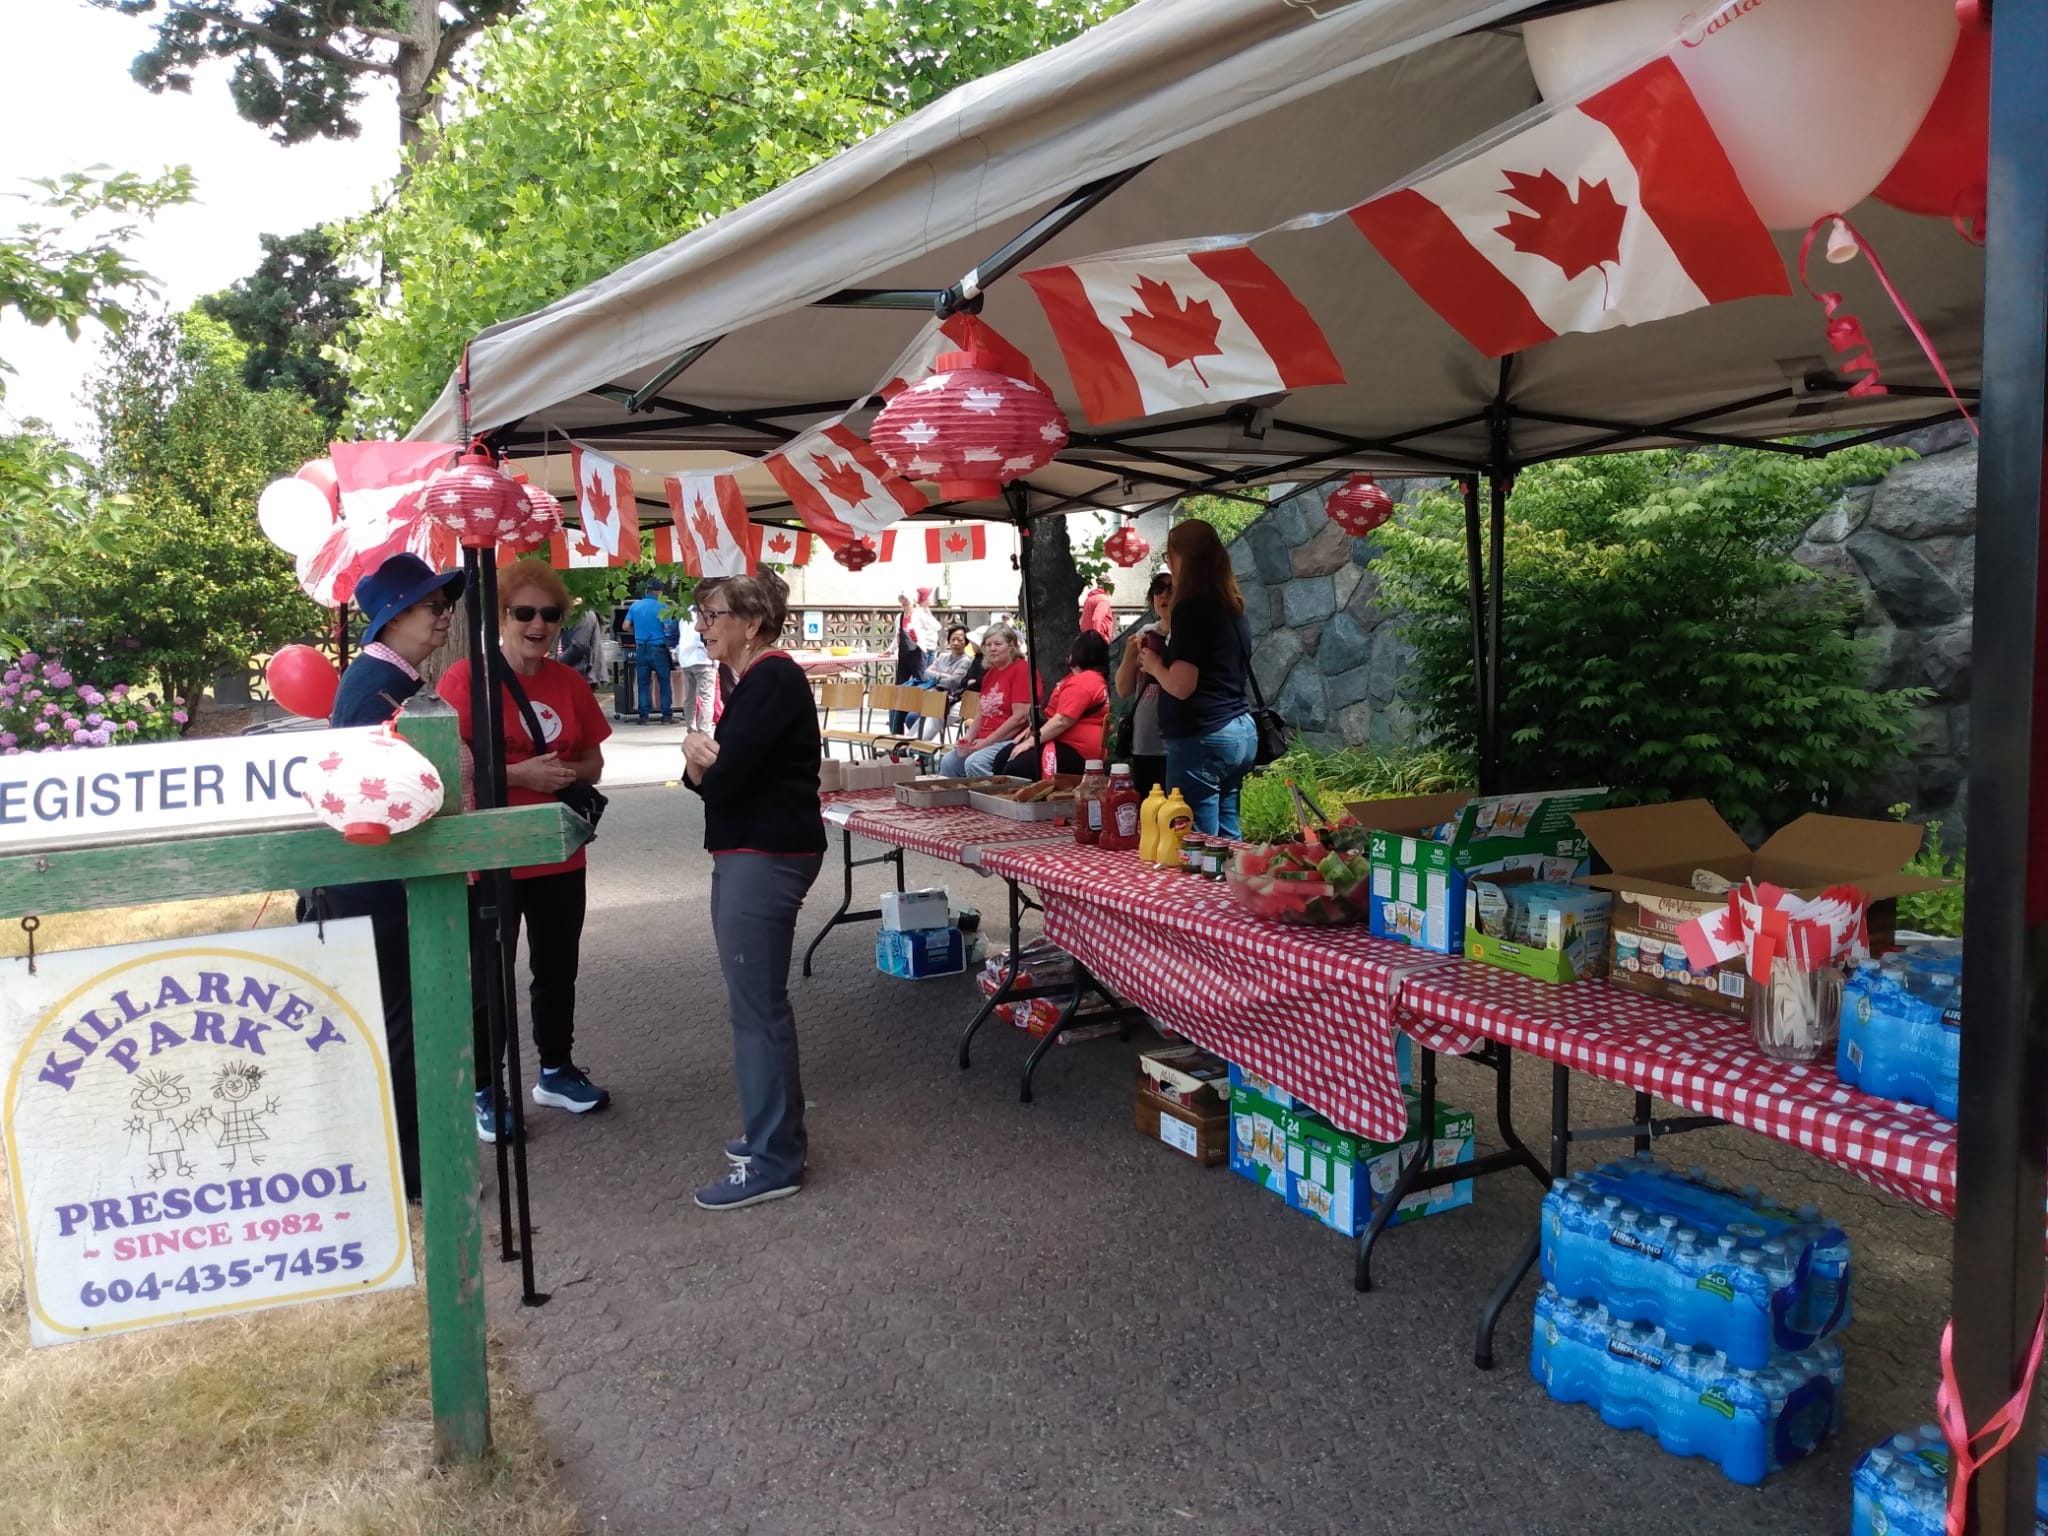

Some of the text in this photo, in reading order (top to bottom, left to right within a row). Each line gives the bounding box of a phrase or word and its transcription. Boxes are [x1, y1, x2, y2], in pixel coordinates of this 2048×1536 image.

[0, 764, 224, 824] EGISTER
[1372, 838, 1386, 852] 24
[1574, 838, 1588, 852] 24
[39, 972, 346, 1090] KILLARNEY
[107, 1010, 272, 1073] PARK
[1287, 1118, 1299, 1132] 24
[1460, 1118, 1472, 1131] 24
[55, 1163, 366, 1237] PRESCHOOL
[113, 1215, 232, 1262] SINCE
[243, 1212, 322, 1241] 1982
[80, 1242, 364, 1308] 604-435-7455
[1611, 1339, 1661, 1366] KIRKLAND
